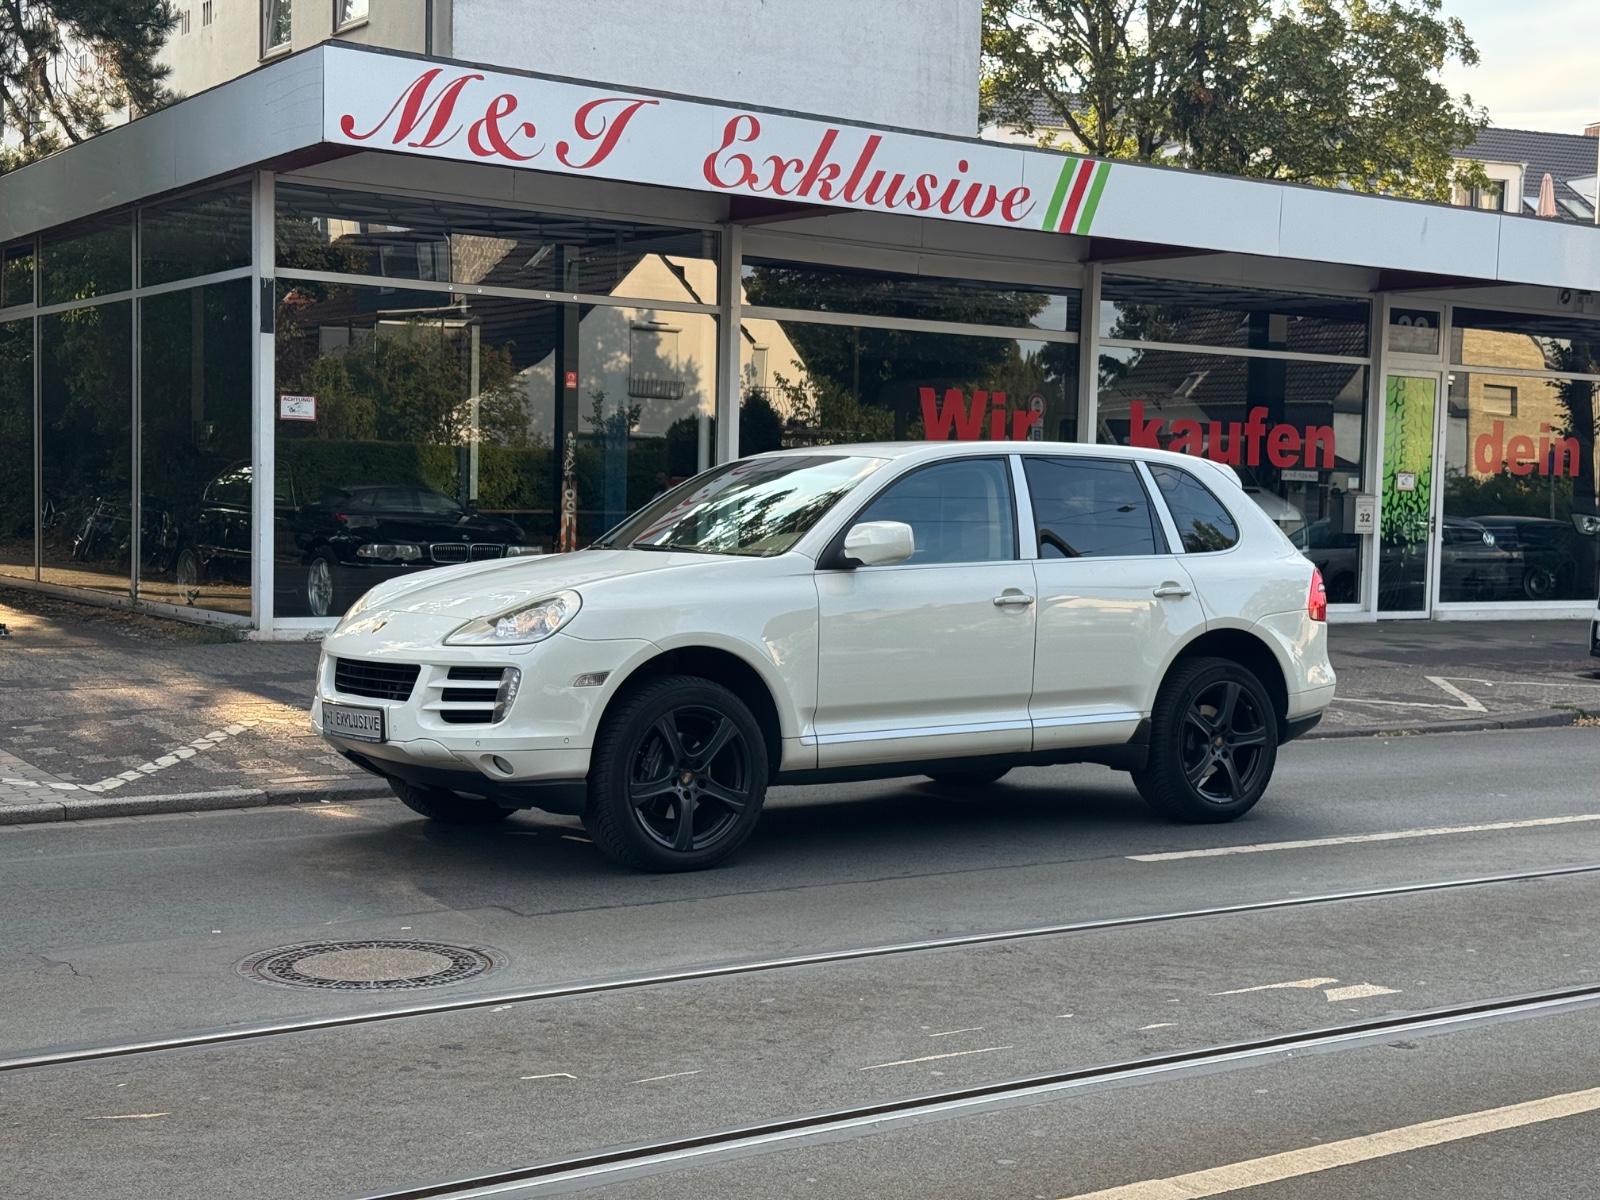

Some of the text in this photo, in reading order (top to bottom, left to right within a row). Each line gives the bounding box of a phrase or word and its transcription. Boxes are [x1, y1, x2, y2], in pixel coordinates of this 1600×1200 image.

[703, 114, 1037, 223] Exklusive
[919, 387, 1581, 477] Wir kaufen dein
[1360, 512, 1371, 523] 32
